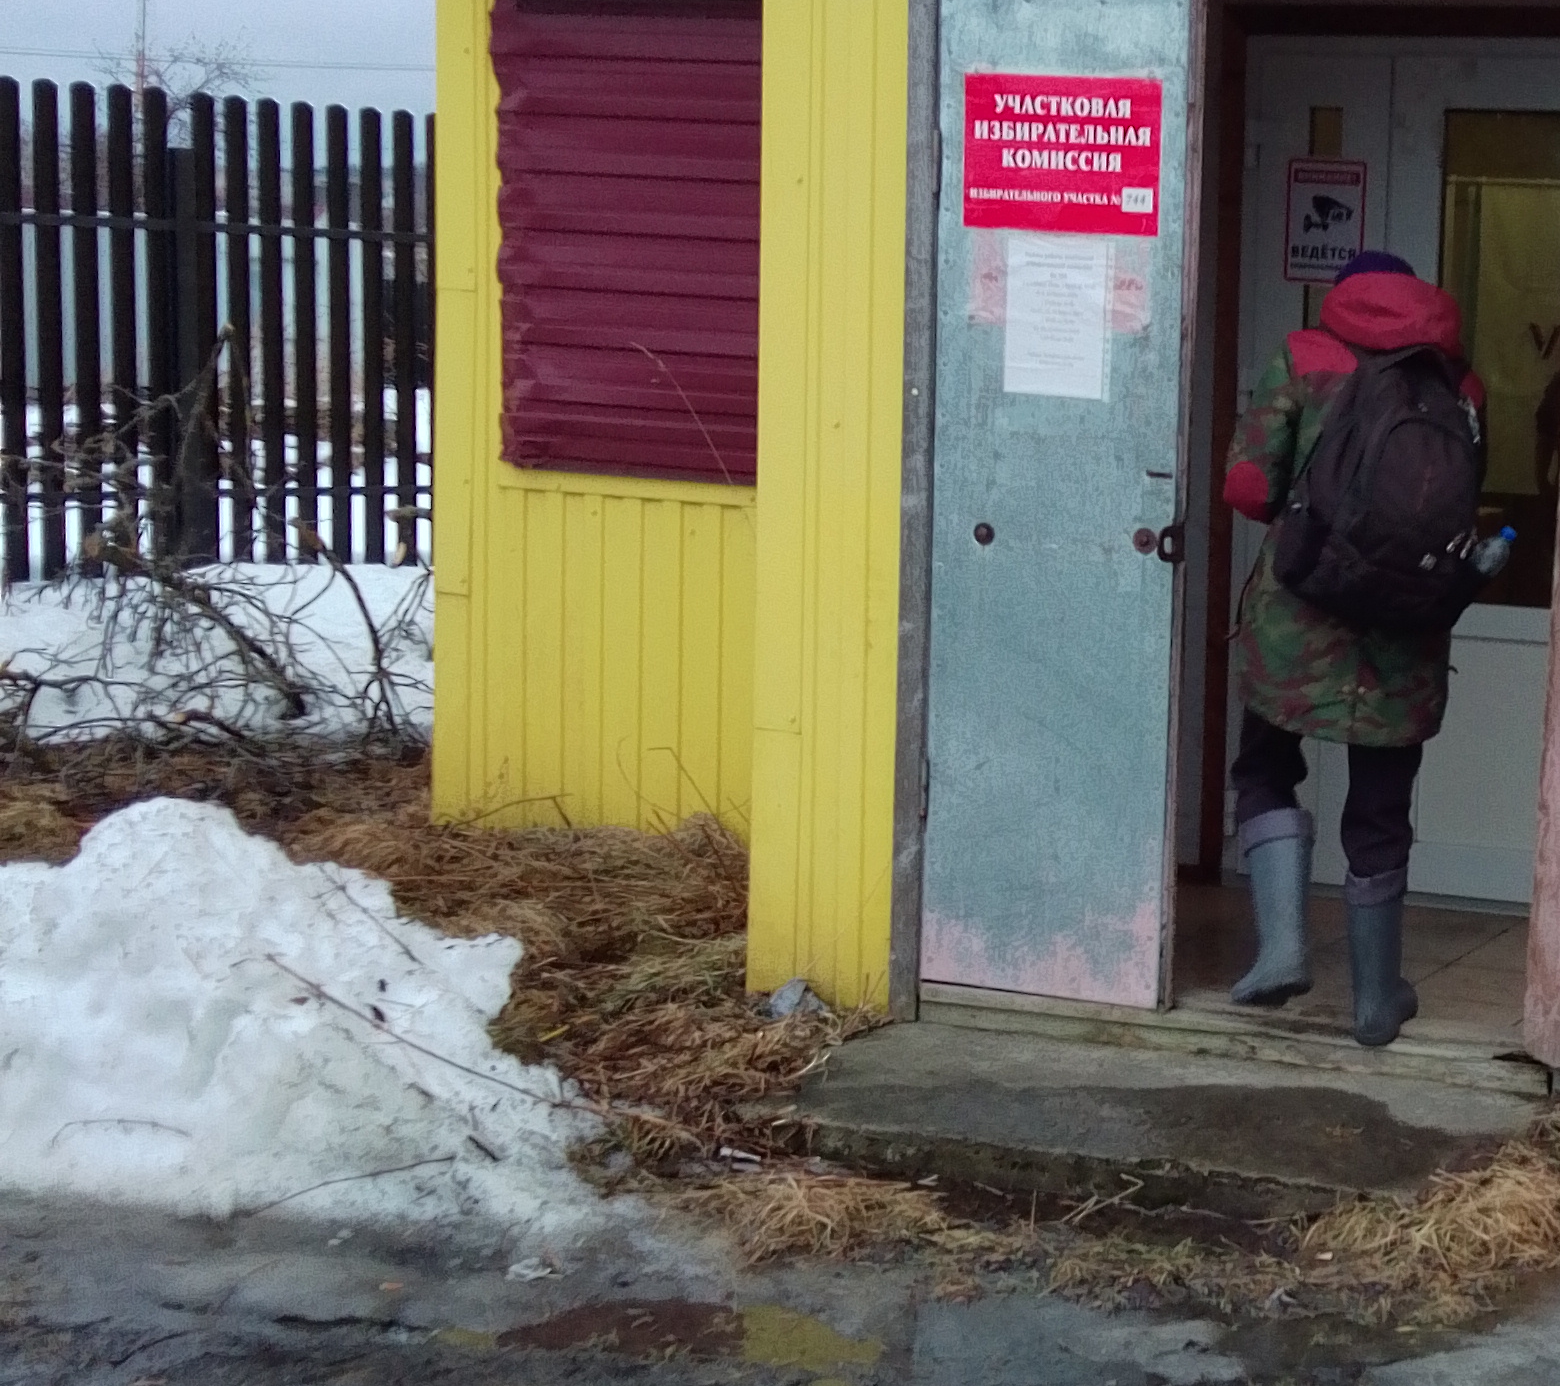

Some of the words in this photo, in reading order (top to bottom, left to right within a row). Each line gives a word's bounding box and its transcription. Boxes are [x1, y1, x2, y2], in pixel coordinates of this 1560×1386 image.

[994, 94, 1132, 119] УЧАСТКОВАЯ
[973, 120, 1151, 147] ИЗБИРАТЕЛЬНАЯ
[1001, 148, 1122, 173] КОМИССИЯ
[969, 187, 1061, 202] ИЗБИРАТЕЛЬНОГО
[1063, 192, 1108, 206] УЧАСТКА
[1291, 243, 1357, 261] ВЕДЁТСЯ
